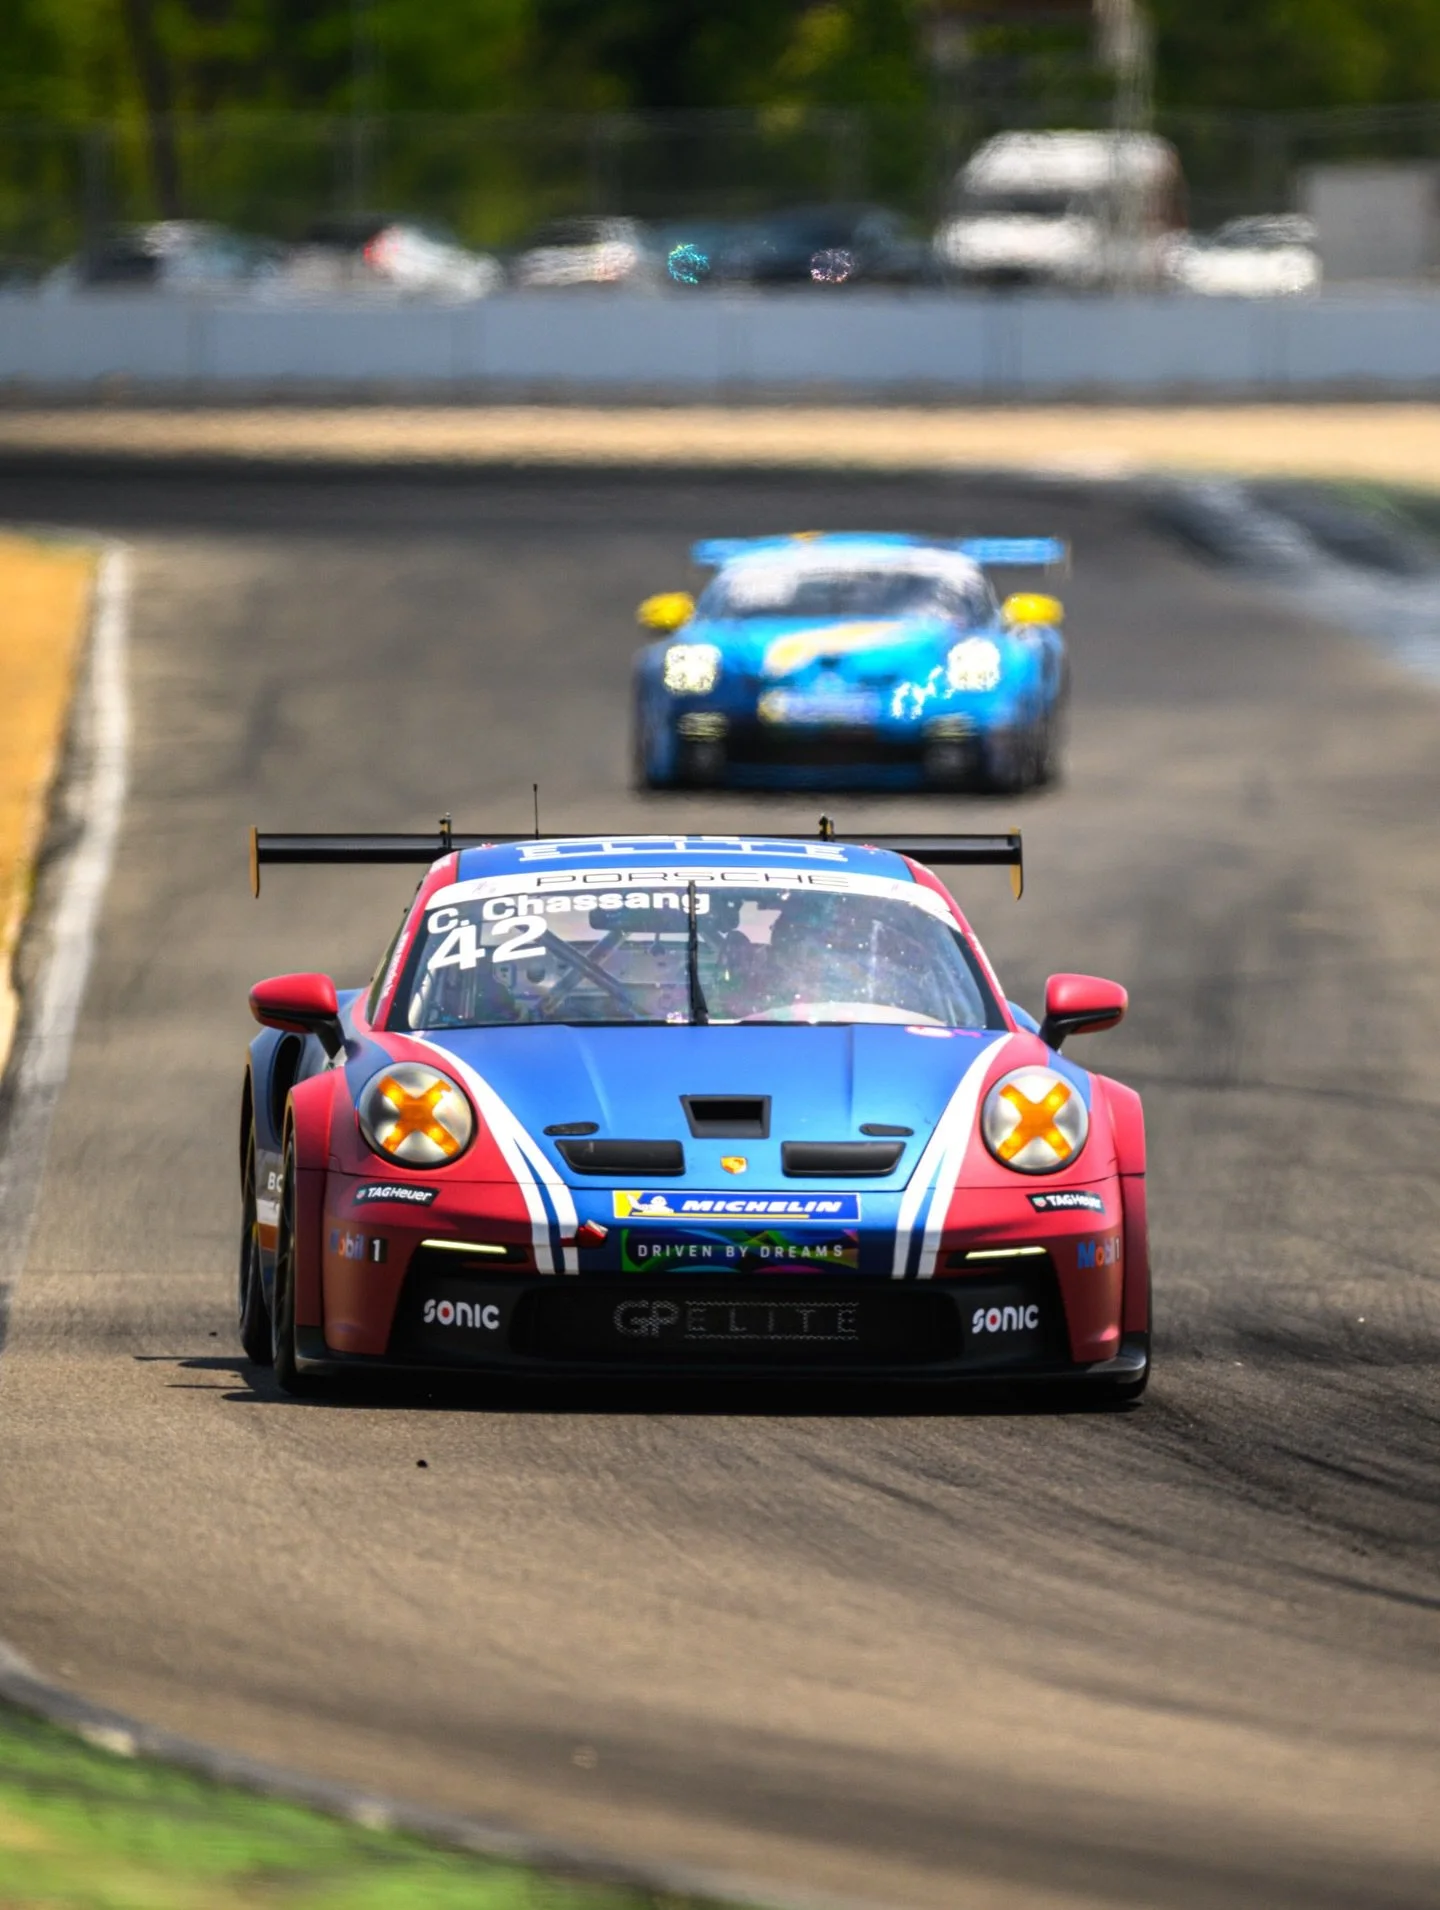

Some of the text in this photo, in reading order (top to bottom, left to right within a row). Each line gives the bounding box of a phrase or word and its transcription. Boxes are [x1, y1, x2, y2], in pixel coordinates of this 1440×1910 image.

[516, 841, 848, 860] ELITE
[537, 871, 850, 887] PORSCHE
[427, 893, 710, 934] C. Chassang
[427, 915, 549, 971] 42
[682, 1199, 843, 1213] MICHELIN
[372, 1239, 381, 1262] 1
[637, 1244, 844, 1259] DRIVEN BY DREAMS
[612, 1299, 858, 1338] GP ELITE
